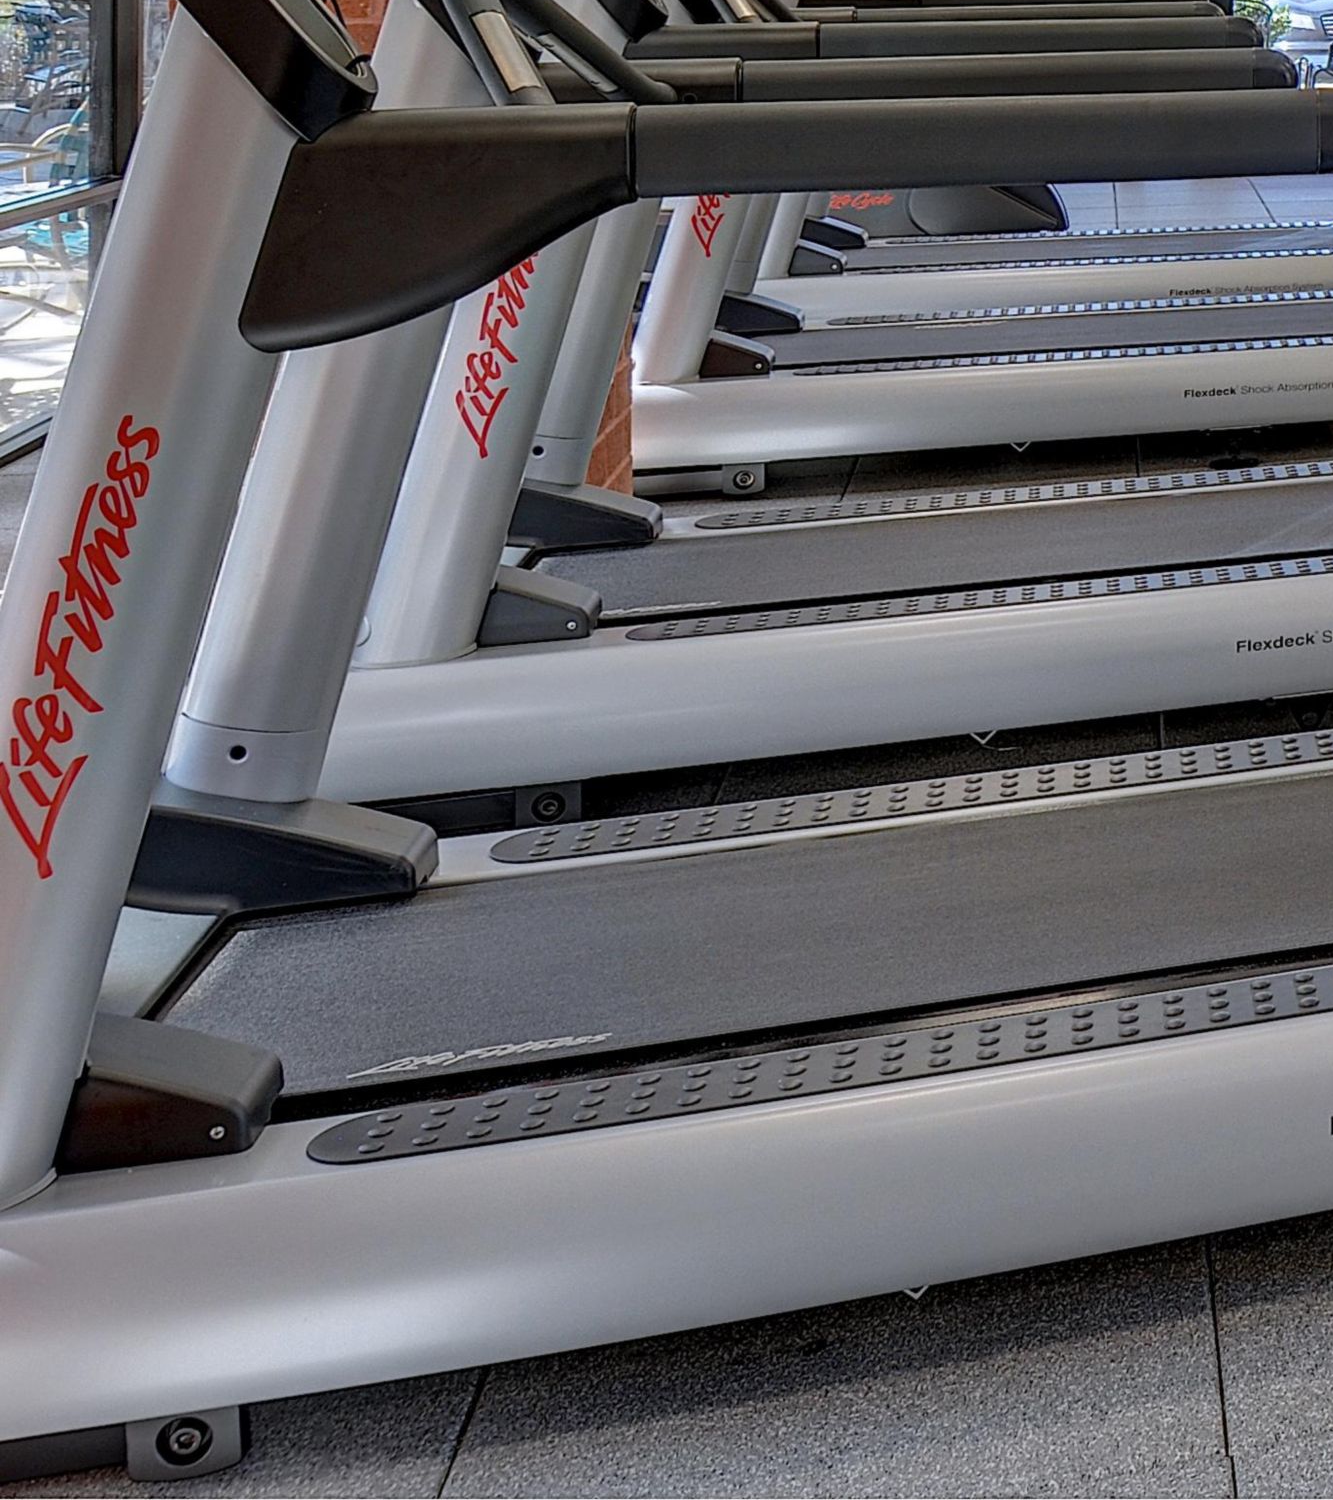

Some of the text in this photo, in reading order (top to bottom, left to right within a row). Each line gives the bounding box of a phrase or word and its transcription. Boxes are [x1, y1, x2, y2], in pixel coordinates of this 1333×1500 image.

[1183, 386, 1237, 398] Flexdeck
[1240, 384, 1275, 395] Shock
[1236, 632, 1316, 653] Flexdeck
